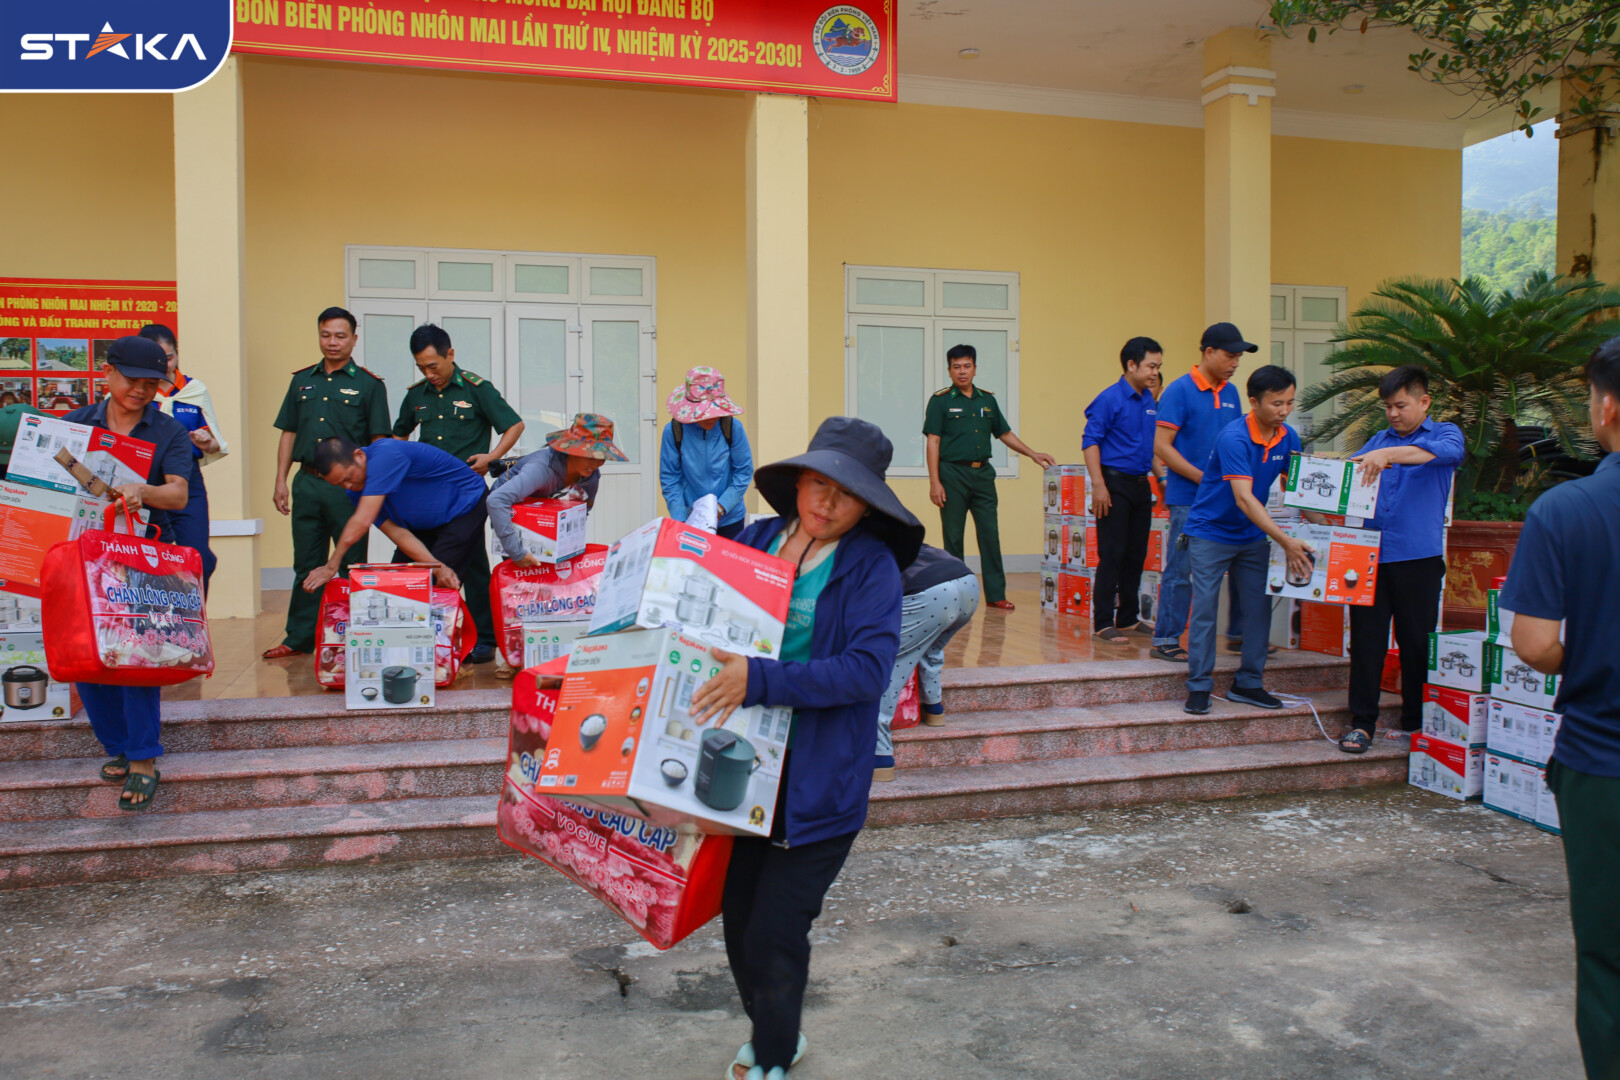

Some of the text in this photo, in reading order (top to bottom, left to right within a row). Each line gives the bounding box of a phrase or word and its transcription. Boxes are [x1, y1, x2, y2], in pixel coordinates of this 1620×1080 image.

[285, 0, 332, 31] BIÊN
[338, 1, 405, 37] PHÒNG
[411, 8, 464, 41] NHÔN
[470, 16, 506, 45] MAI
[512, 12, 548, 48] LẦN
[553, 20, 590, 51] THỨ
[617, 26, 675, 62] NHIỆM
[680, 30, 702, 60] KỲ
[707, 37, 802, 68] 2025-2030!
[7, 295, 40, 310] PHÒNG
[41, 296, 68, 311] NHÔN
[70, 298, 88, 311] MAI
[90, 297, 120, 314] NHIỆM
[121, 297, 134, 312] KỲ
[135, 300, 157, 312] 2020
[22, 315, 38, 327] VÀ
[64, 317, 100, 329] TRANH
[100, 540, 185, 564] THÀNH CÔNG
[513, 557, 605, 578] THÀNH CÔNG
[106, 583, 140, 604] CHĂN
[140, 583, 169, 606] LÔNG
[169, 590, 188, 609] CAO
[516, 593, 597, 618] CHĂN LÔNG CAO
[557, 812, 608, 853] VOGUE
